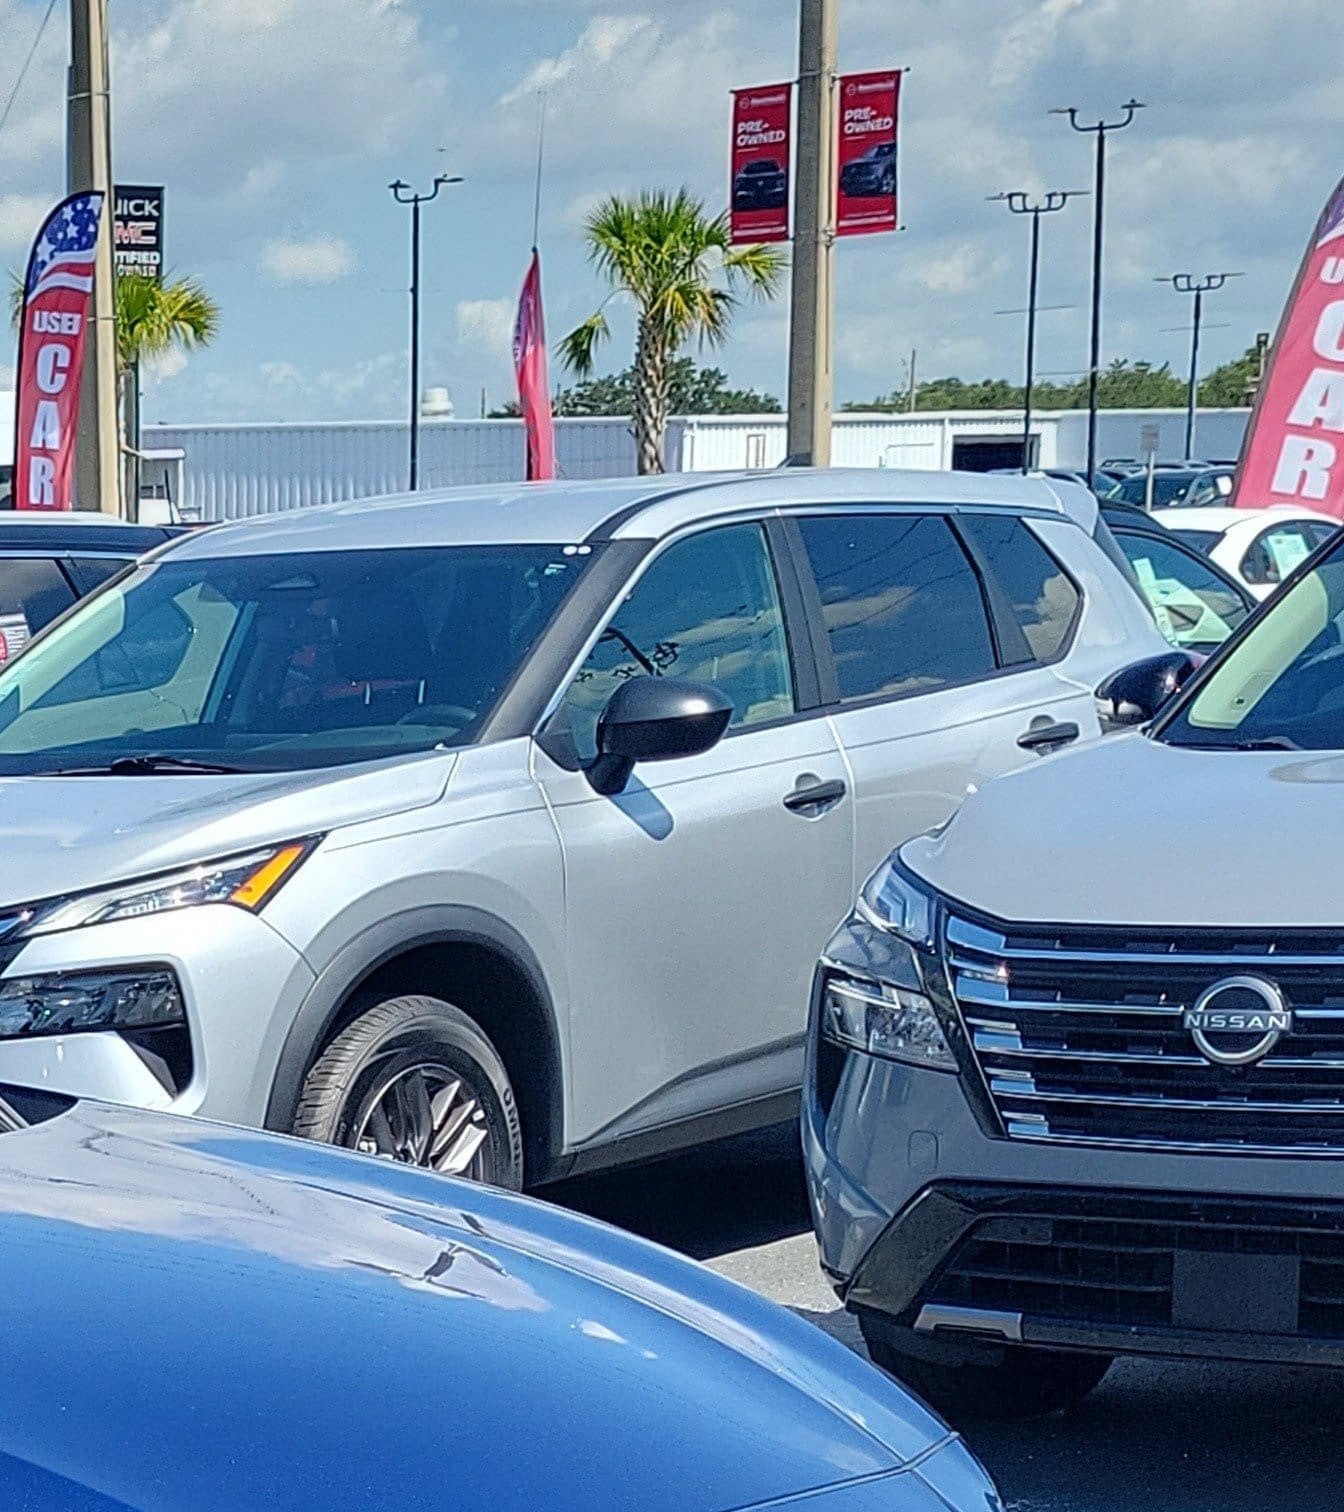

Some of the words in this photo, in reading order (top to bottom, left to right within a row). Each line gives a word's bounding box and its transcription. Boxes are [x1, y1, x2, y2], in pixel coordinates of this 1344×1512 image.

[844, 118, 893, 134] OWNED
[737, 130, 786, 147] OWNED
[114, 198, 160, 217] UICK
[115, 221, 157, 244] MC
[1187, 1013, 1287, 1029] NISSAN
